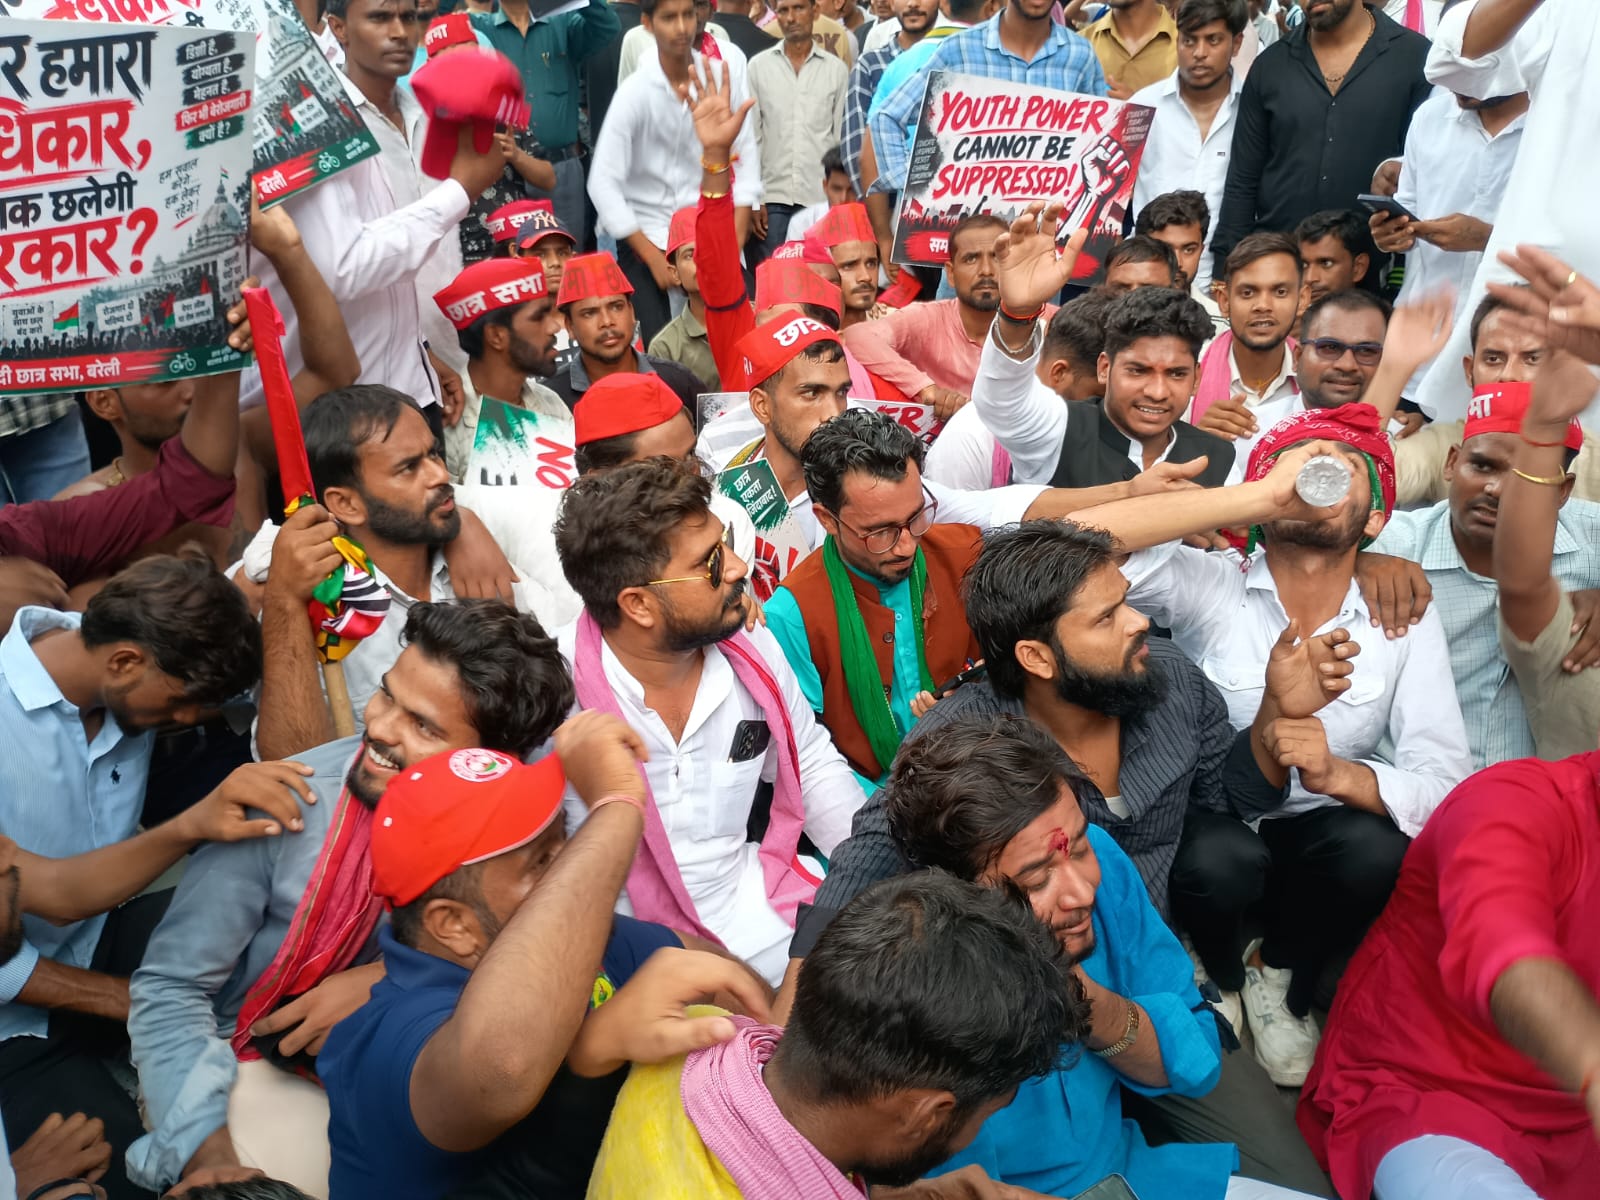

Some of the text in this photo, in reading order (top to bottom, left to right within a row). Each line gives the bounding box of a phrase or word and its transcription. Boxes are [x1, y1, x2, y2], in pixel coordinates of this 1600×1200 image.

[36, 31, 159, 106] हमारा
[936, 91, 1110, 134] YOUTH POWER
[0, 97, 153, 175] धिकार,
[953, 135, 1076, 162] CANNOT BE
[258, 170, 287, 194] बरेली
[932, 163, 1079, 199] SUPPRESSED!
[0, 171, 138, 231] क छलेगी
[0, 207, 159, 291] रकार?
[445, 272, 543, 322] छात्र सभा
[15, 367, 46, 384] छात्र
[49, 365, 84, 382] सभा,
[86, 357, 121, 379] बरेली
[733, 470, 752, 491] छात्र
[740, 478, 763, 503] एकता
[745, 485, 778, 517] जिंदाबाद!
